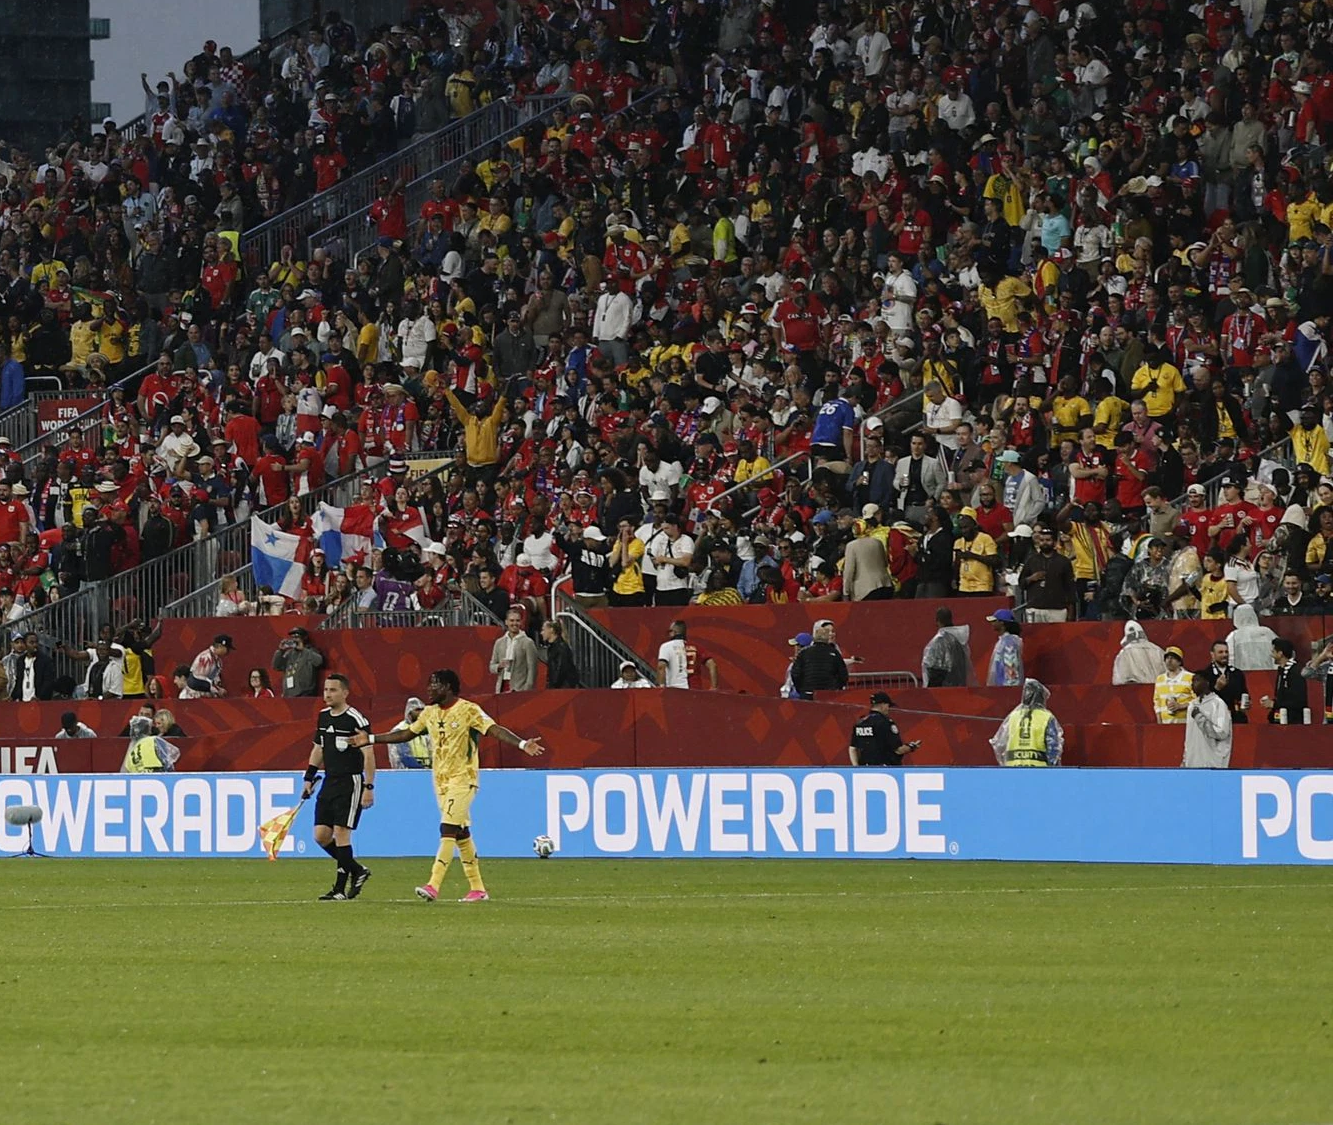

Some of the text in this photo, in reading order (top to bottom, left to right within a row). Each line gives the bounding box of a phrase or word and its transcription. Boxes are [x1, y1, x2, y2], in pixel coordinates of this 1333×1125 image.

[58, 408, 79, 419] FIFA
[819, 402, 838, 415] 26
[855, 726, 873, 737] POLICE
[546, 772, 946, 853] POWERADE
[1241, 774, 1333, 859] PO
